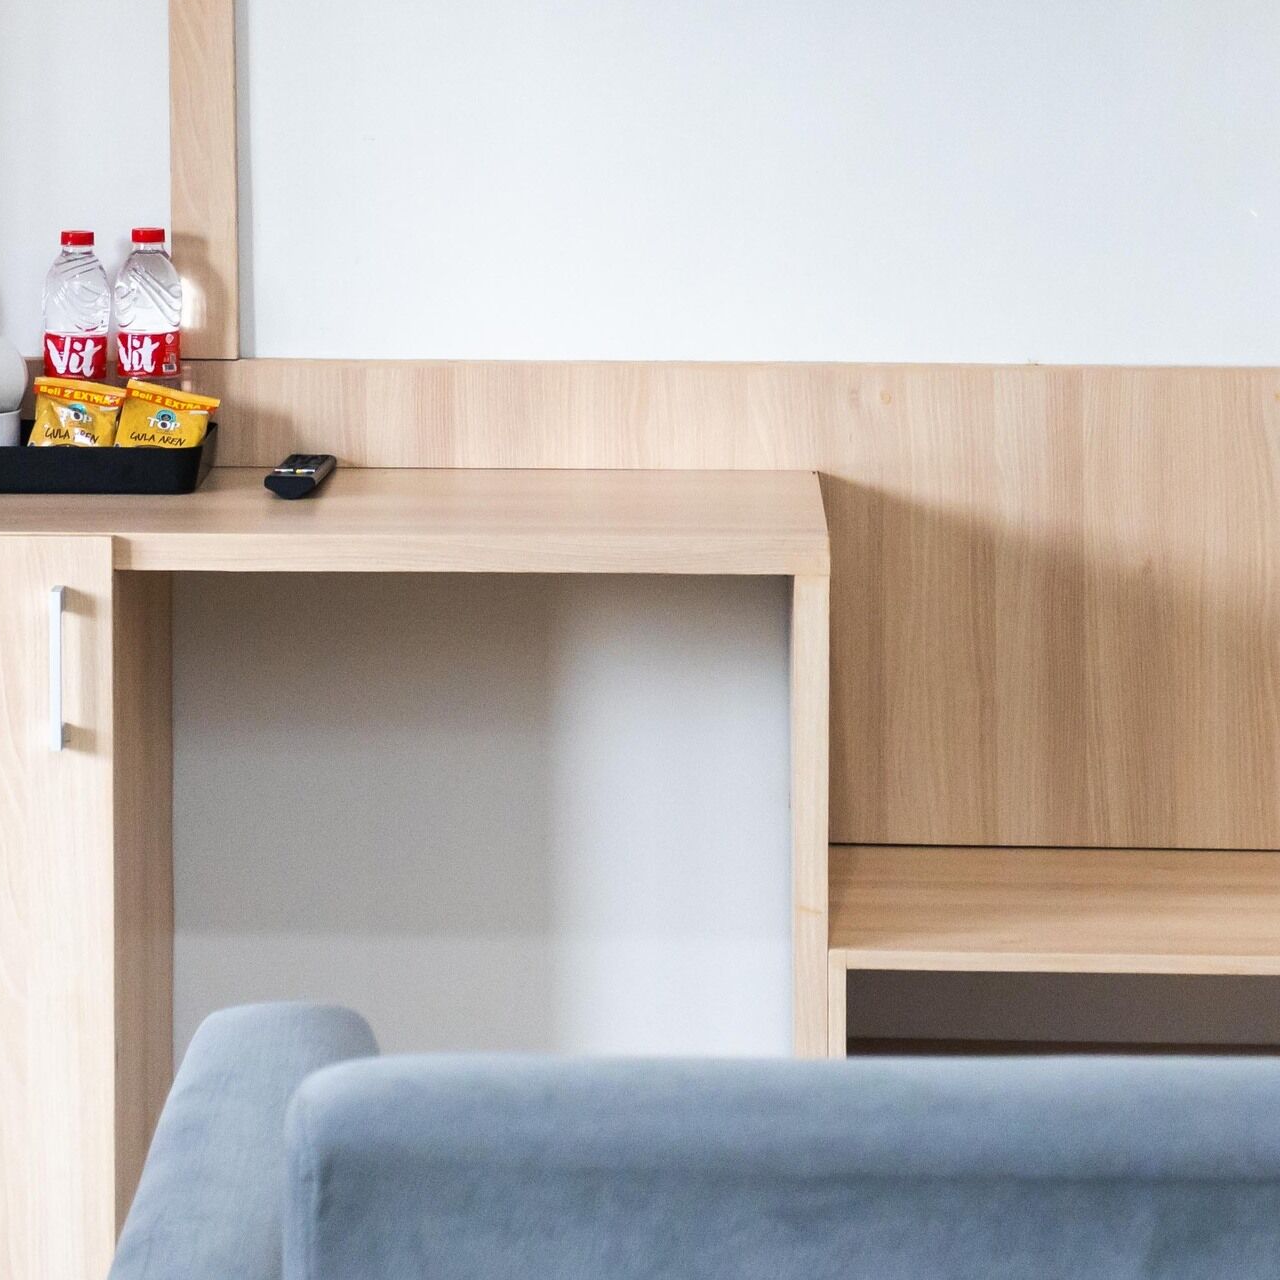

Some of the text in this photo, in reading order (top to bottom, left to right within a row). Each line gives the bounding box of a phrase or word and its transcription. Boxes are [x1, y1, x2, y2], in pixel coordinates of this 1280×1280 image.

[47, 336, 102, 377] Vit
[117, 333, 160, 373] Vit
[39, 385, 61, 396] Beli
[64, 389, 72, 398] 2
[131, 390, 153, 401] Beli
[155, 396, 163, 404] 2
[147, 416, 181, 431] TOP
[45, 427, 70, 439] GULA
[130, 431, 186, 446] GULA AREN
